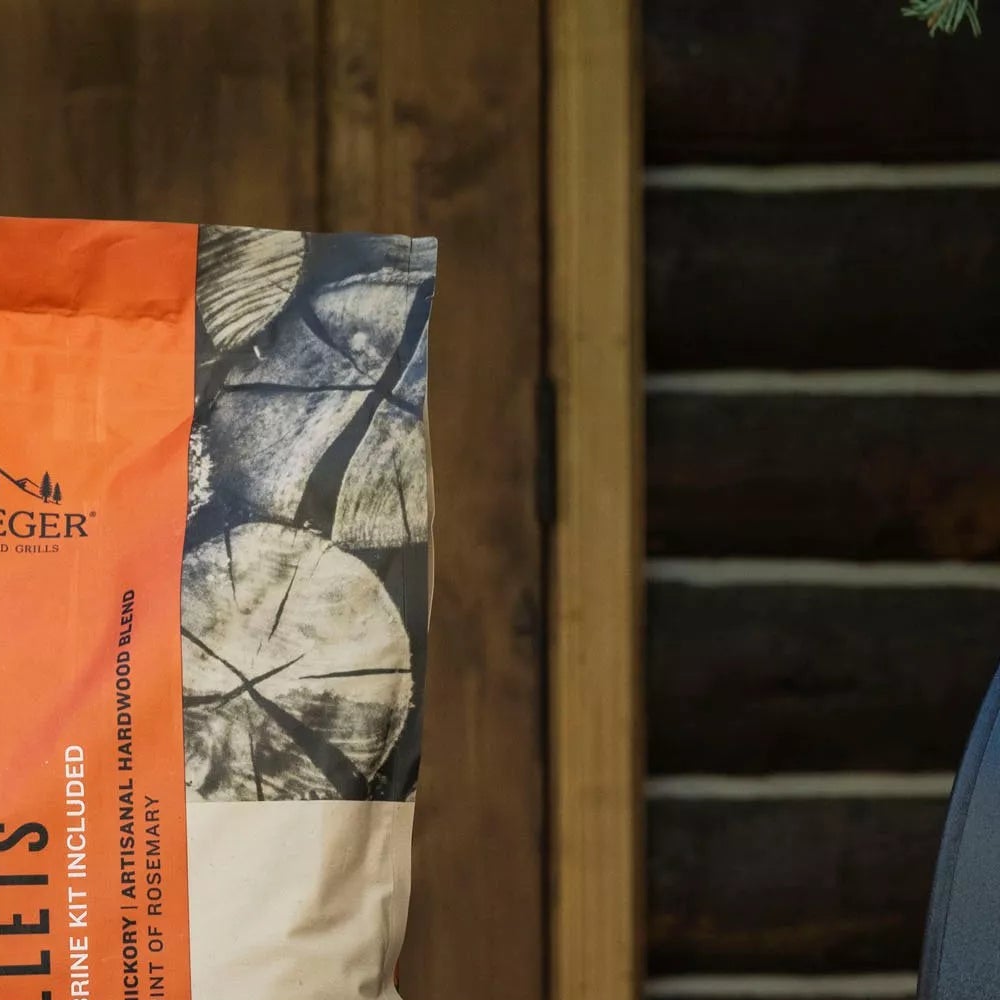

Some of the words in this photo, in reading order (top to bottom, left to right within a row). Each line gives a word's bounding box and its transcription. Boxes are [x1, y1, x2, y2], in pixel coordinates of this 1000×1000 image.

[15, 544, 60, 553] GRILLS
[118, 589, 135, 647] BLEND
[115, 651, 133, 771] HARDWOOD
[64, 745, 87, 878] INCLUDED
[118, 777, 137, 898] ARTISANAL
[145, 795, 162, 916] ROSEMARY
[68, 887, 87, 927] KIT
[148, 925, 164, 953] OF
